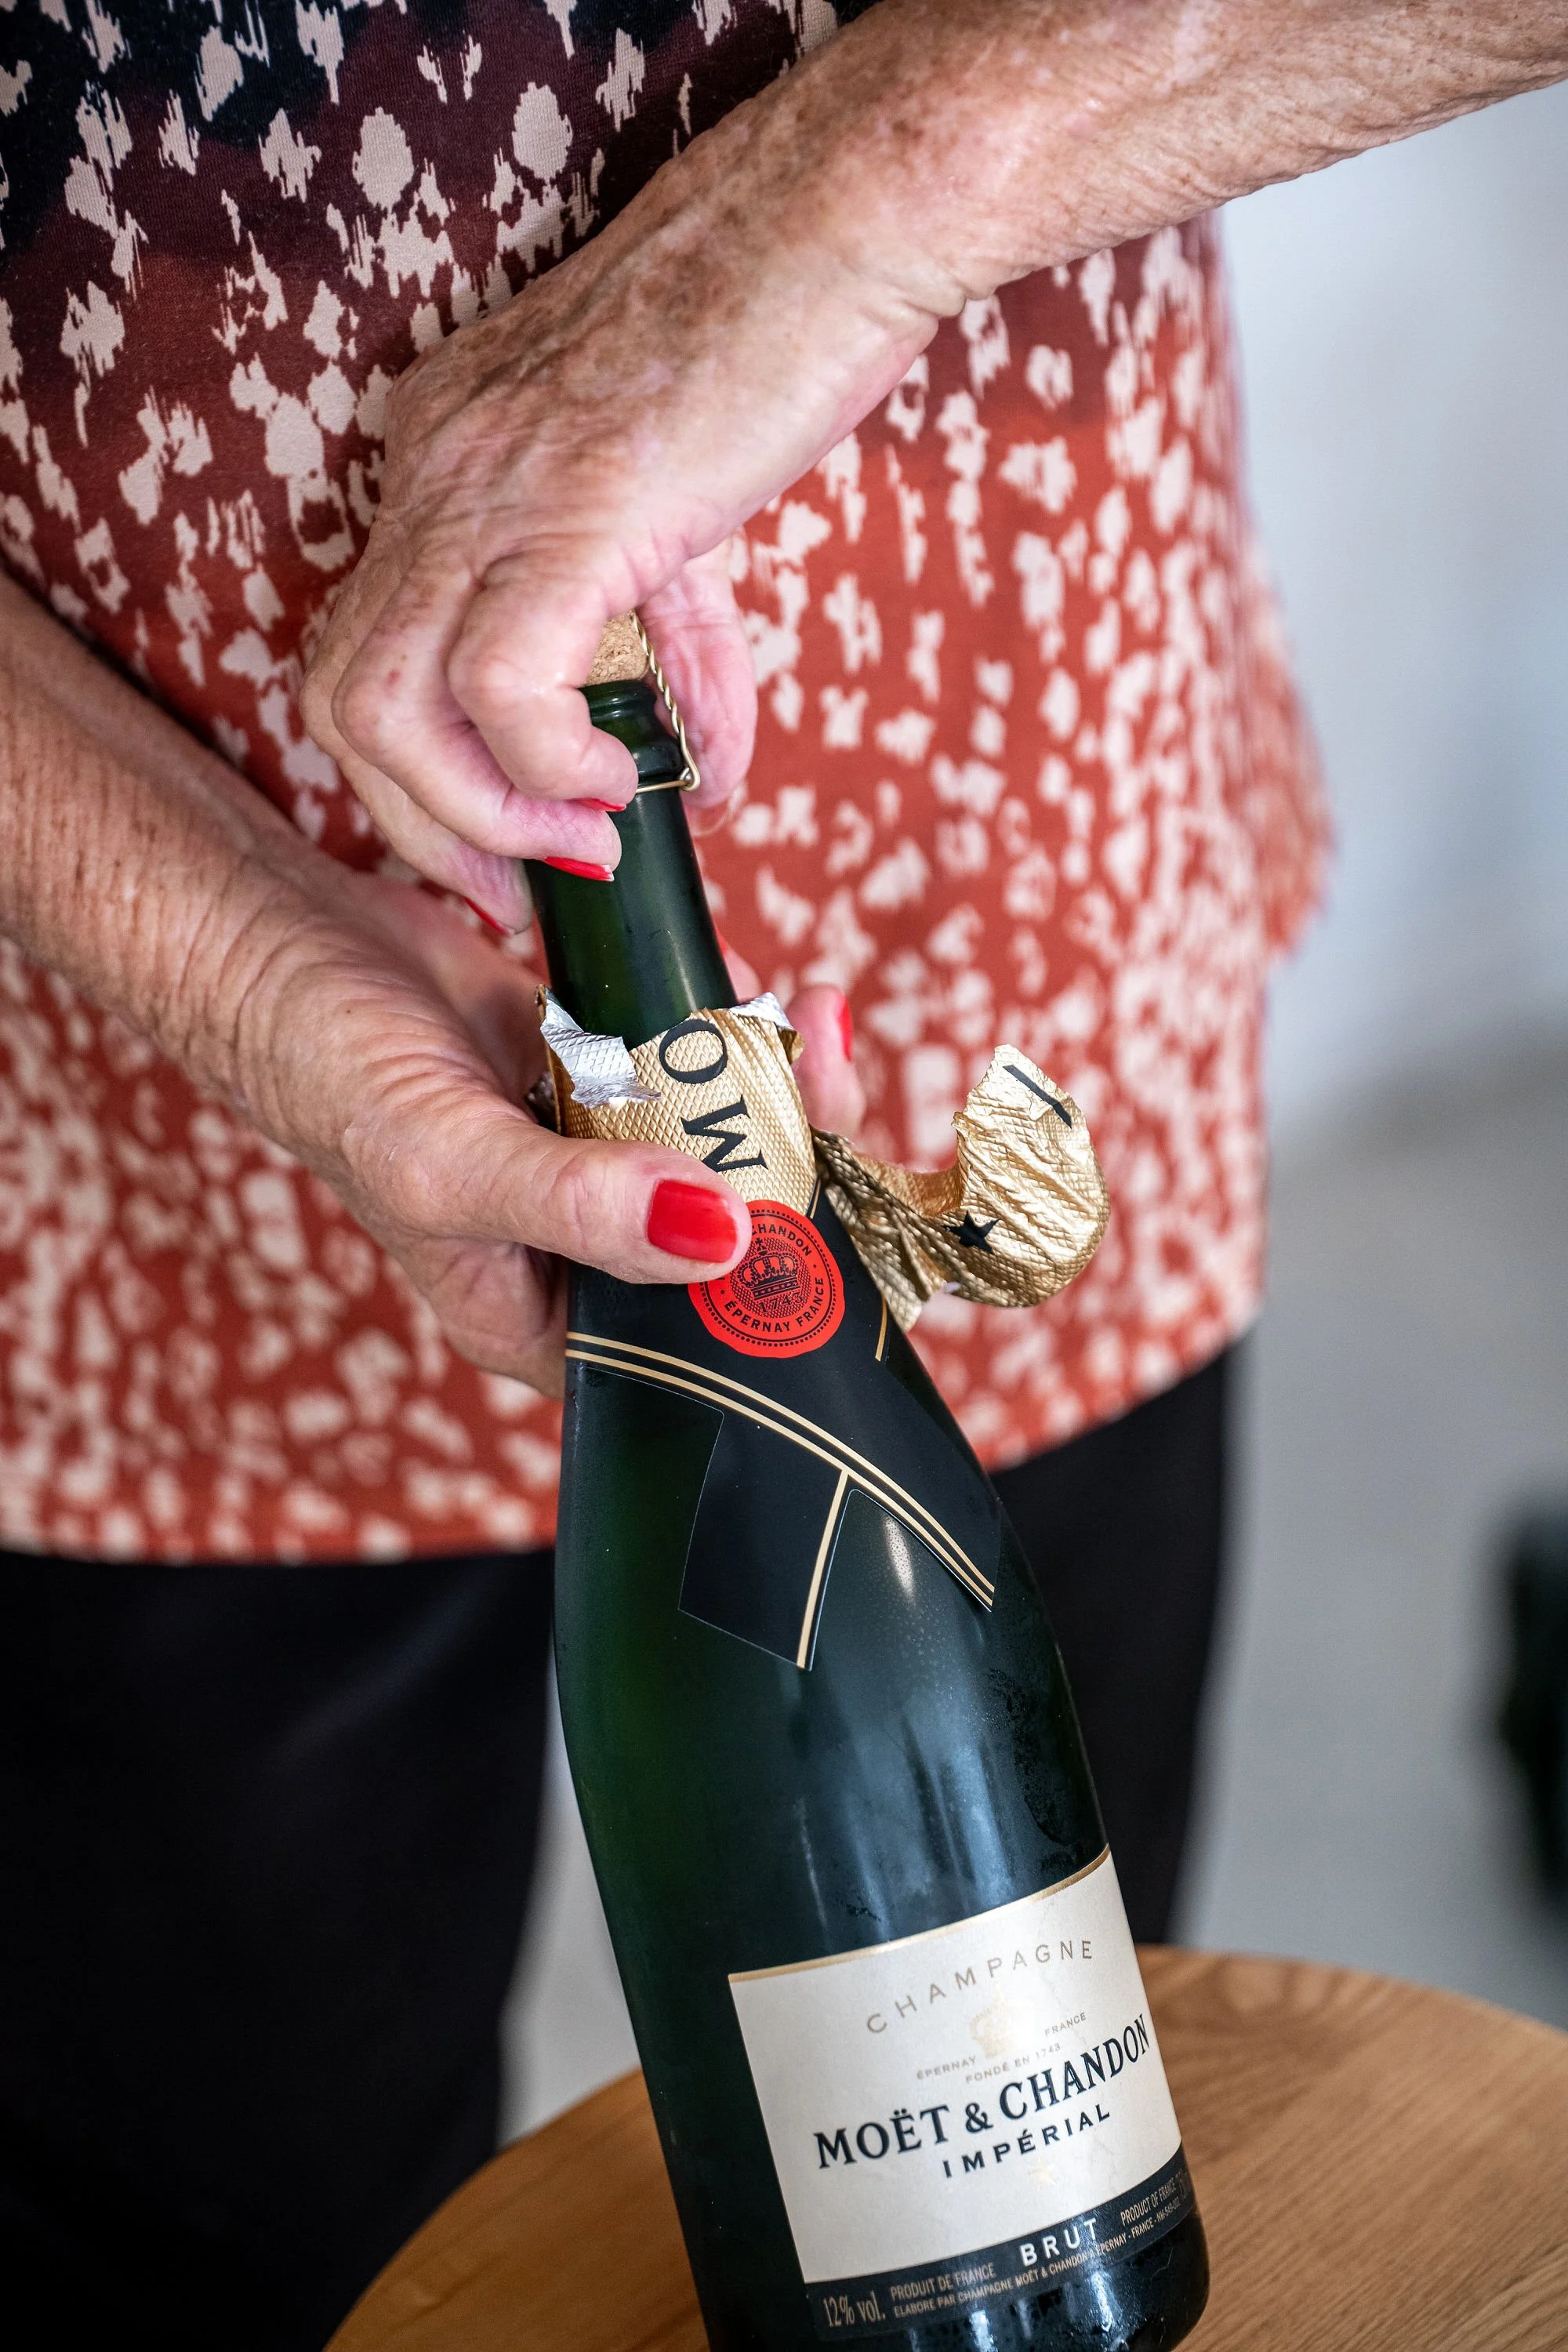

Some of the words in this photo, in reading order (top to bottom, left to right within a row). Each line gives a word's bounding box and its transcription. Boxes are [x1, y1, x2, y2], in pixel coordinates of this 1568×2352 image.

[724, 1300, 790, 1333] ÉPERNAY
[796, 1276, 824, 1327] FRANCE
[759, 1291, 804, 1314] 1743
[866, 1940, 1093, 2034] CHAMPAGNE
[1044, 2012, 1087, 2037] FRANCE
[965, 2062, 1011, 2084] FONDÉ
[1014, 2055, 1030, 2068] EN
[1036, 2042, 1061, 2060] 1743
[813, 2104, 950, 2169] MOËT
[964, 2102, 994, 2135] &
[999, 2013, 1151, 2121] CHANDON
[942, 2103, 1111, 2179] IMPÉRIAL
[1120, 2198, 1151, 2227] PRODUCT
[1151, 2191, 1159, 2207] OF
[1159, 2177, 1176, 2201] FRANCE
[938, 2294, 956, 2309] PAR
[958, 2277, 1014, 2303] CHAMPAGNE
[1049, 2252, 1088, 2274] CHANDON
[1131, 2218, 1154, 2238] FRANCE
[1020, 2217, 1097, 2267] BRUT
[890, 2278, 935, 2302] PRODUIT
[938, 2274, 953, 2292] DE
[954, 2263, 996, 2285] FRANCE
[823, 2295, 855, 2327] 12%
[856, 2290, 886, 2322] vol.
